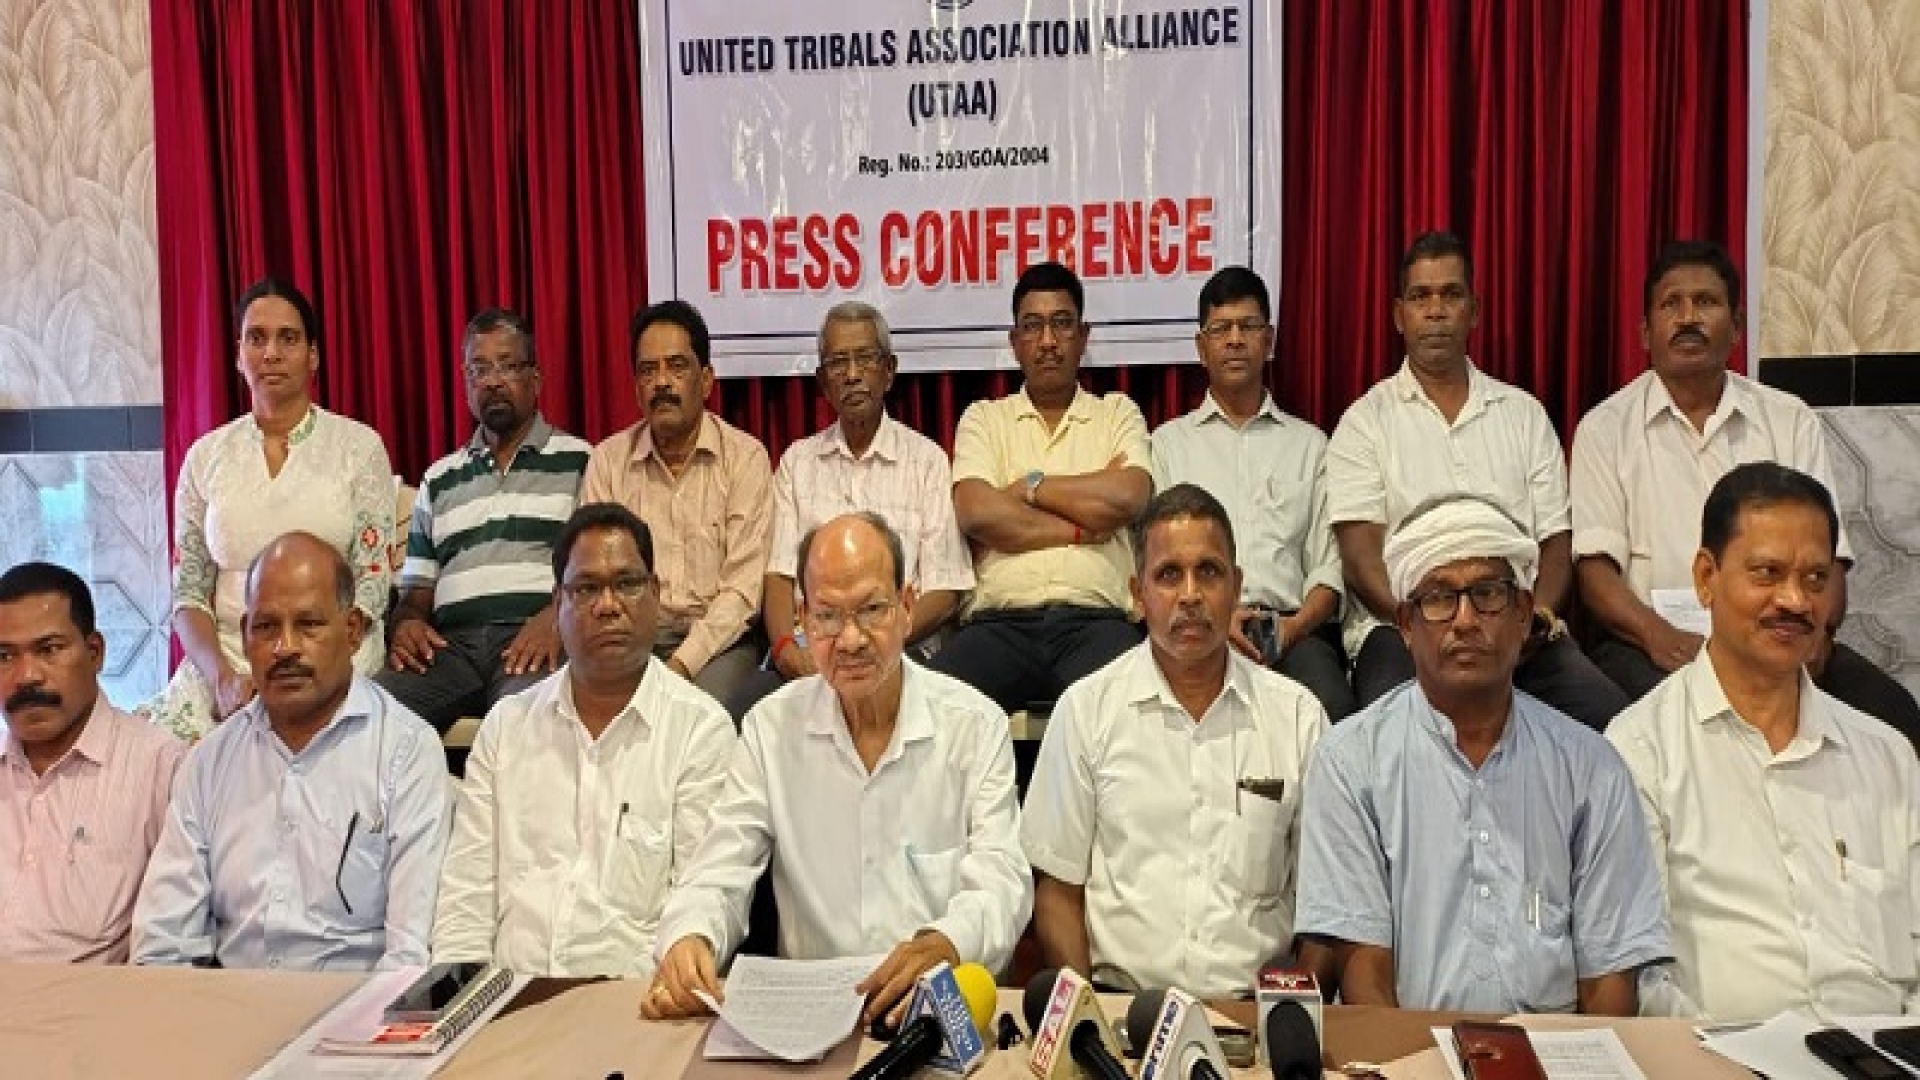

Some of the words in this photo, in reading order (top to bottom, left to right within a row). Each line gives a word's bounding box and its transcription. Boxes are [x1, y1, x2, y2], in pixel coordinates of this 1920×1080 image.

[679, 36, 774, 76] UNITED
[784, 29, 897, 71] TRIBALS
[906, 18, 1090, 64] ASSOCIATION
[1102, 8, 1239, 51] ALLIANCE
[908, 78, 998, 127] (UTAA)
[858, 155, 894, 177] Reg.
[899, 152, 930, 172] No.:
[935, 145, 1050, 170] 203/GOA/2004
[706, 212, 864, 294] PRESS
[879, 196, 1214, 288] CONFERENCE
